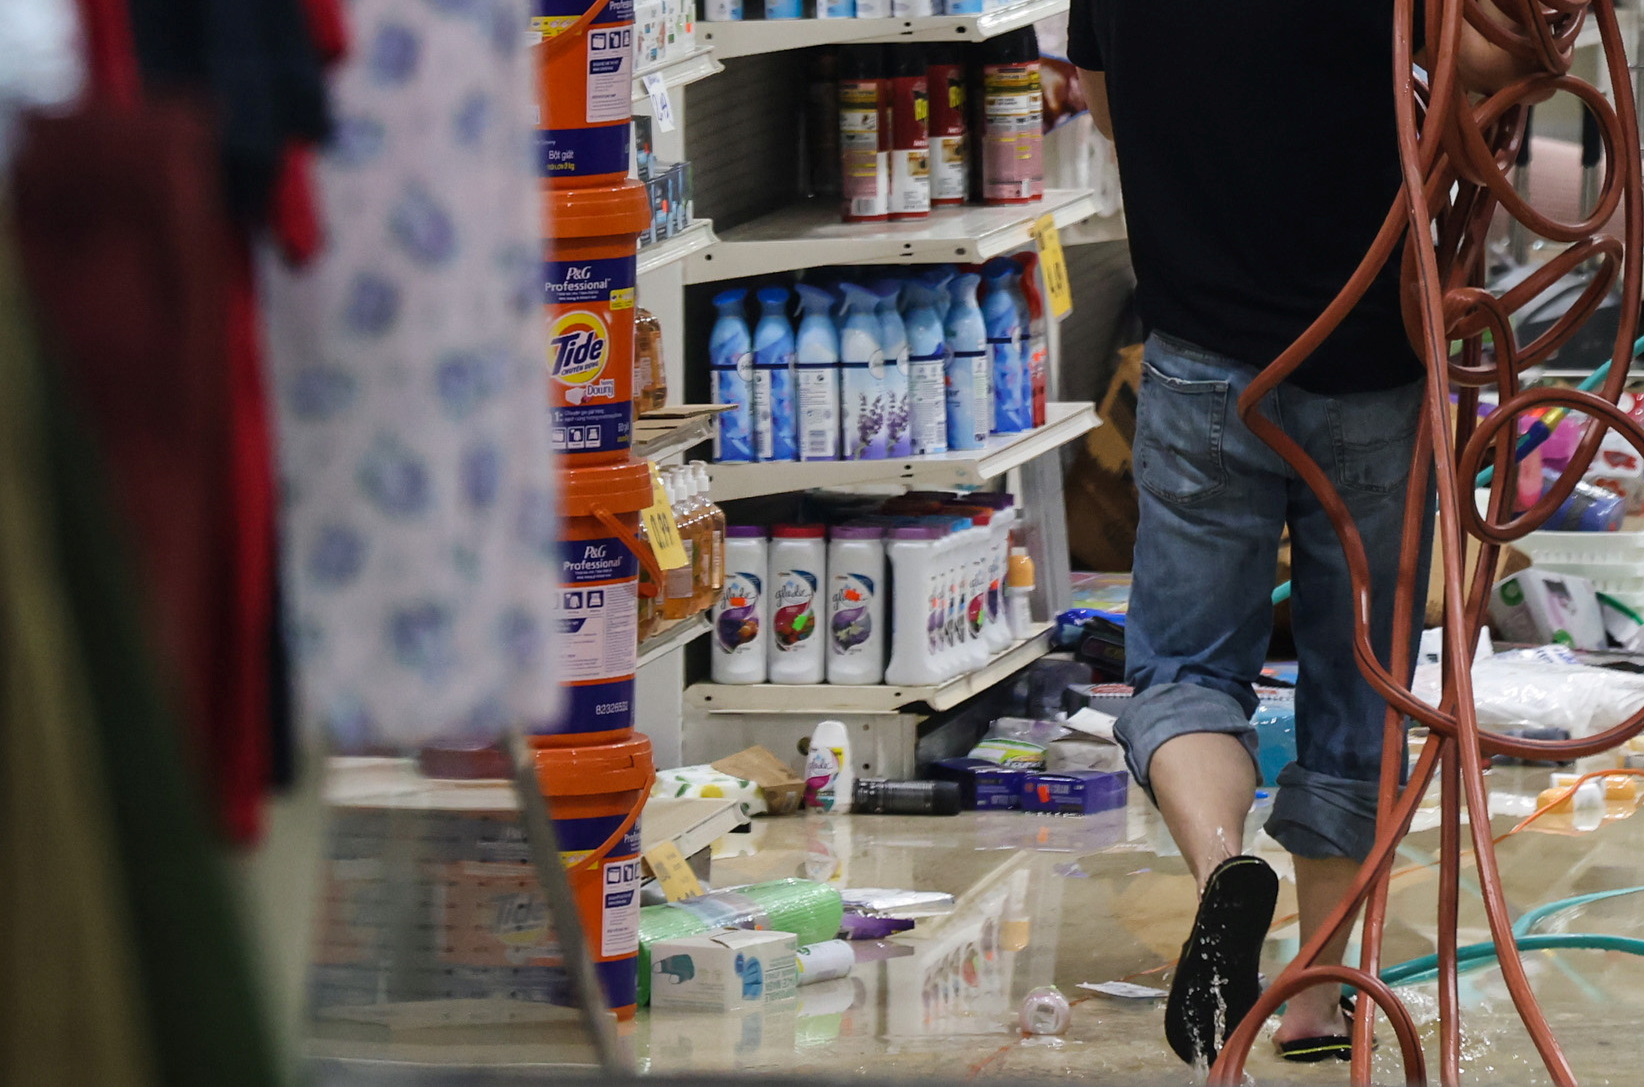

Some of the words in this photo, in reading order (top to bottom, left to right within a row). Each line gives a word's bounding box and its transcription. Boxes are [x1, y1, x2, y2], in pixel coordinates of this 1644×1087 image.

[610, 0, 633, 11] Profess
[566, 266, 591, 280] P&G
[545, 279, 607, 292] Professional
[551, 331, 604, 376] Tide
[587, 384, 614, 396] Downy
[584, 545, 607, 559] P&G
[563, 557, 621, 571] Professional
[775, 586, 806, 606] glade
